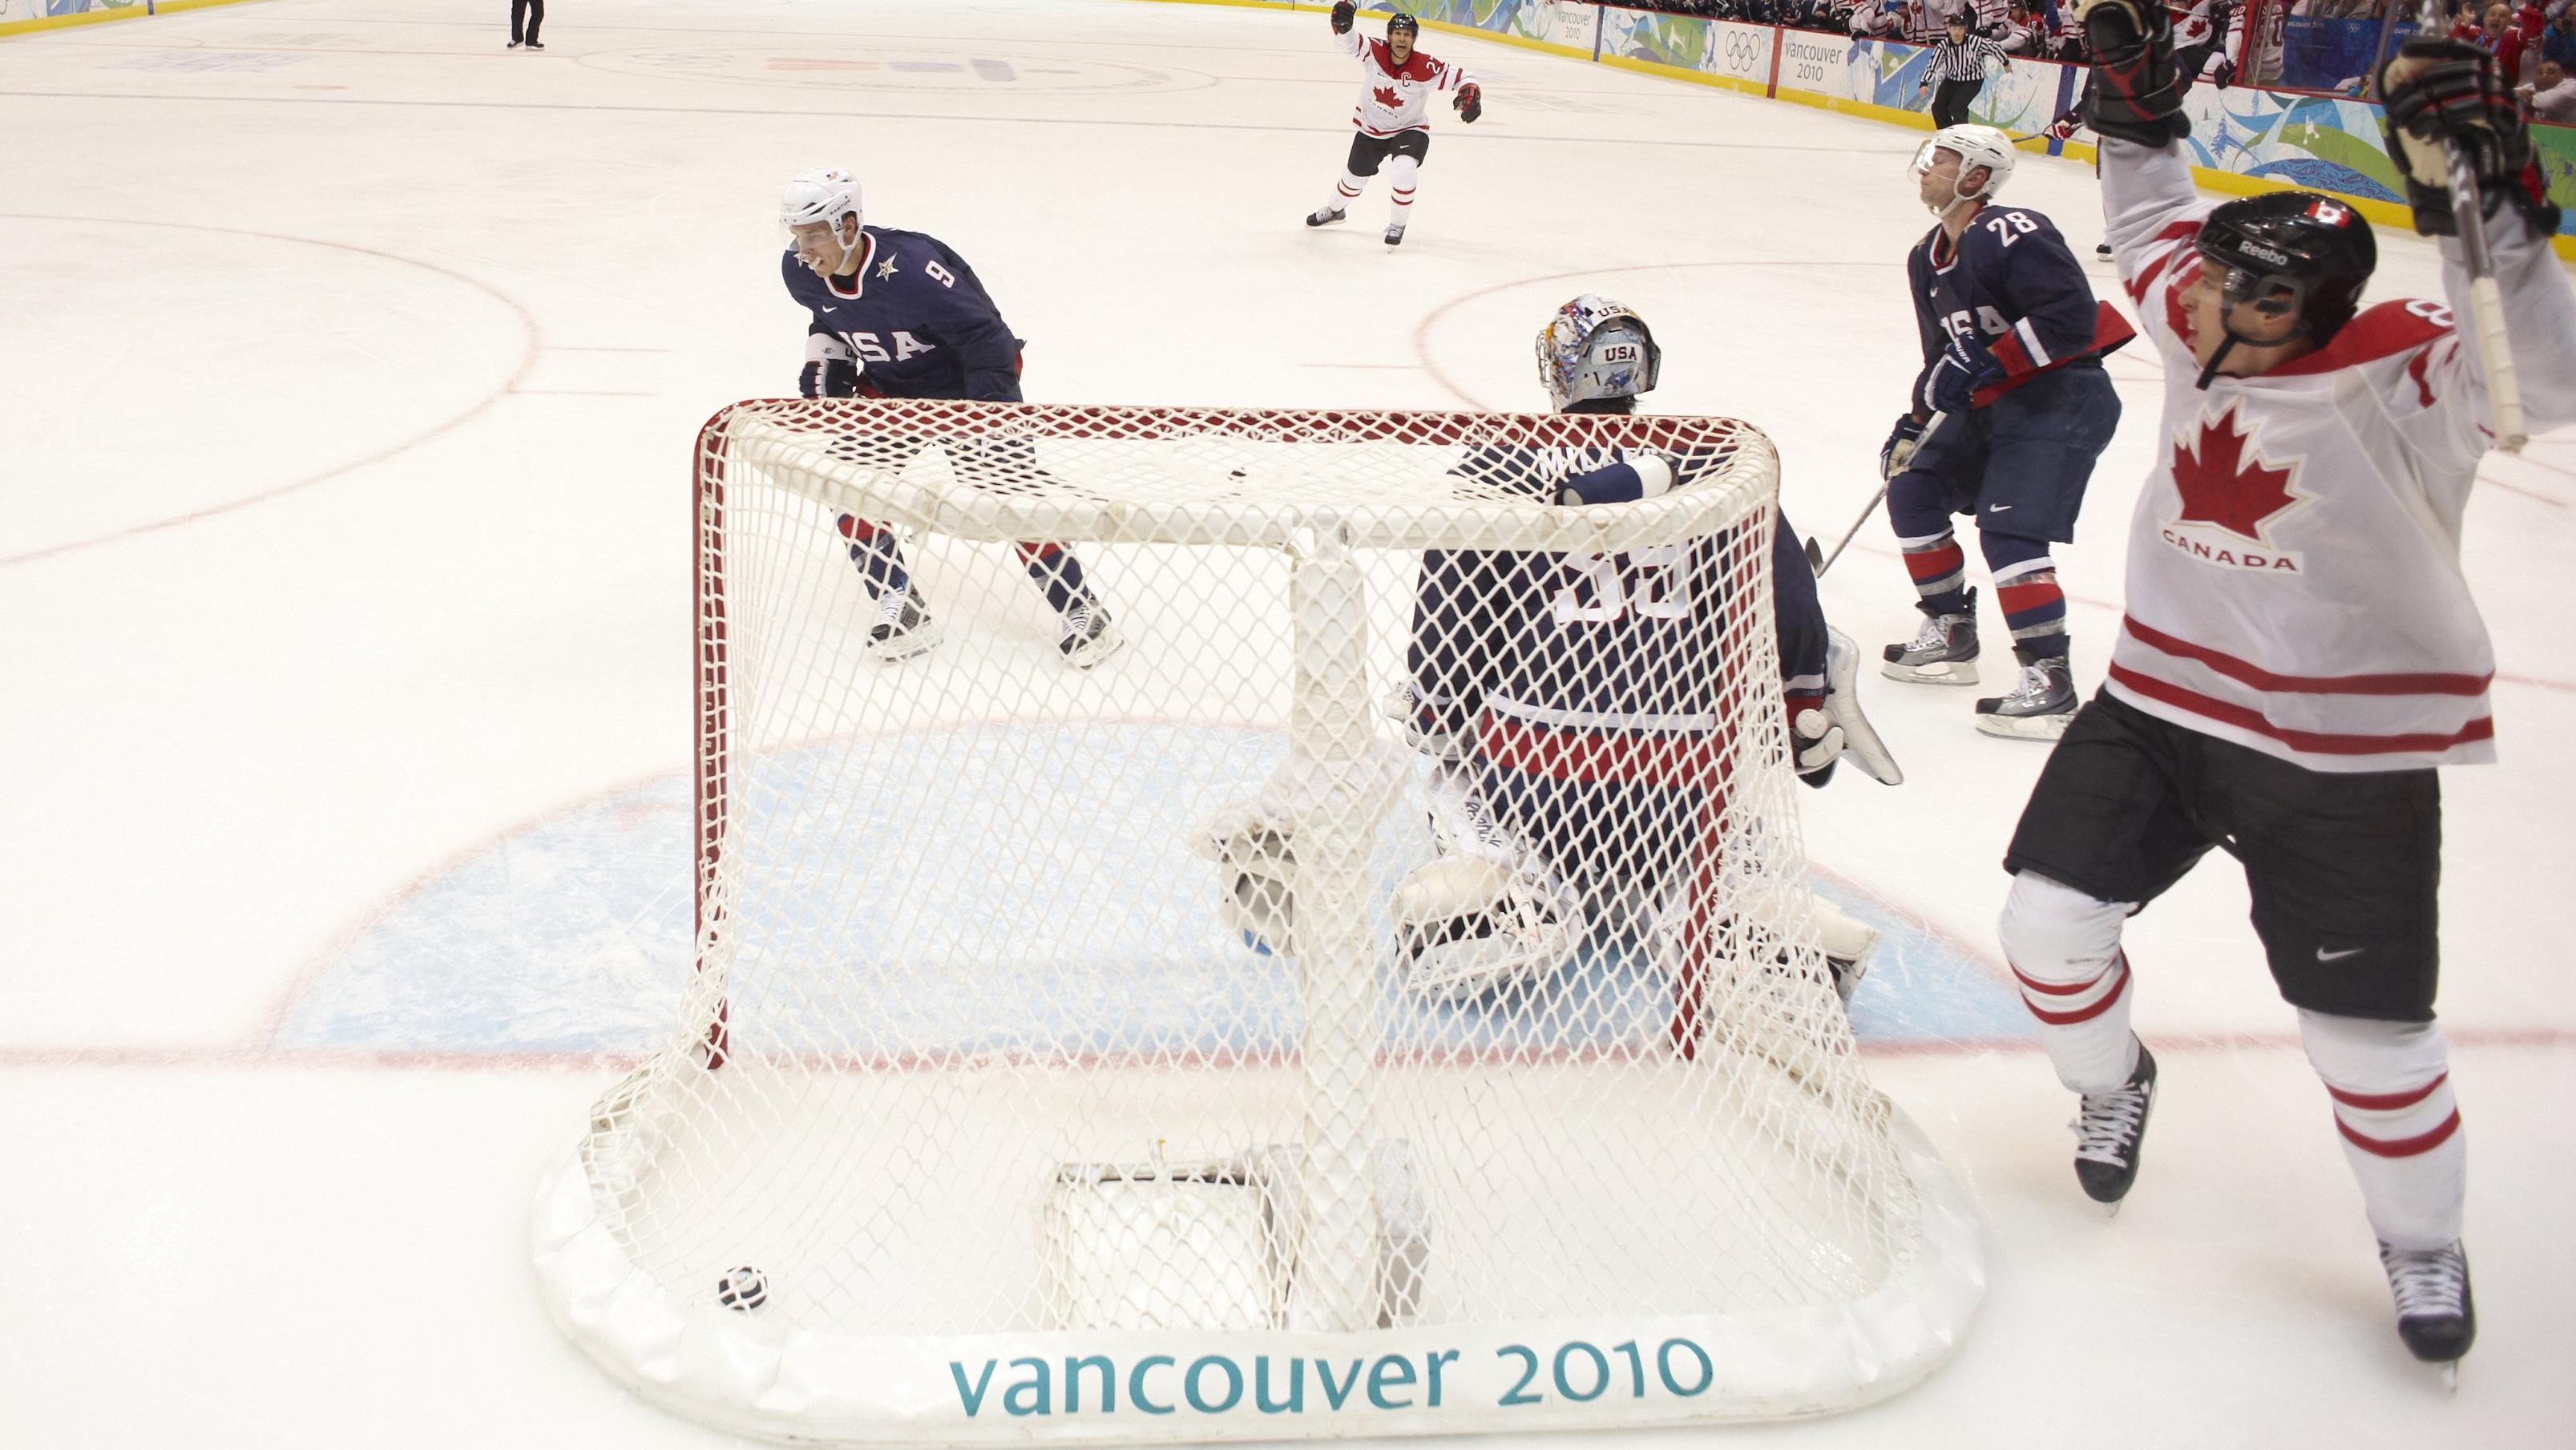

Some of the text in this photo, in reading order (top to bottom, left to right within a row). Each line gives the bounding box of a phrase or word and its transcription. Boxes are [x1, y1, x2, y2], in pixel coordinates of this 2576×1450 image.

[1558, 11, 1591, 26] vancouver
[1565, 26, 1581, 39] 2010
[1785, 42, 1842, 64] vancouver
[1401, 72, 1411, 87] C
[1797, 63, 1823, 81] 2010
[1986, 212, 2038, 248] 28
[925, 260, 956, 288] 9
[1605, 346, 1637, 361] USA
[2162, 529, 2298, 572] CANADA
[949, 1338, 1713, 1417] vancouver 2010
